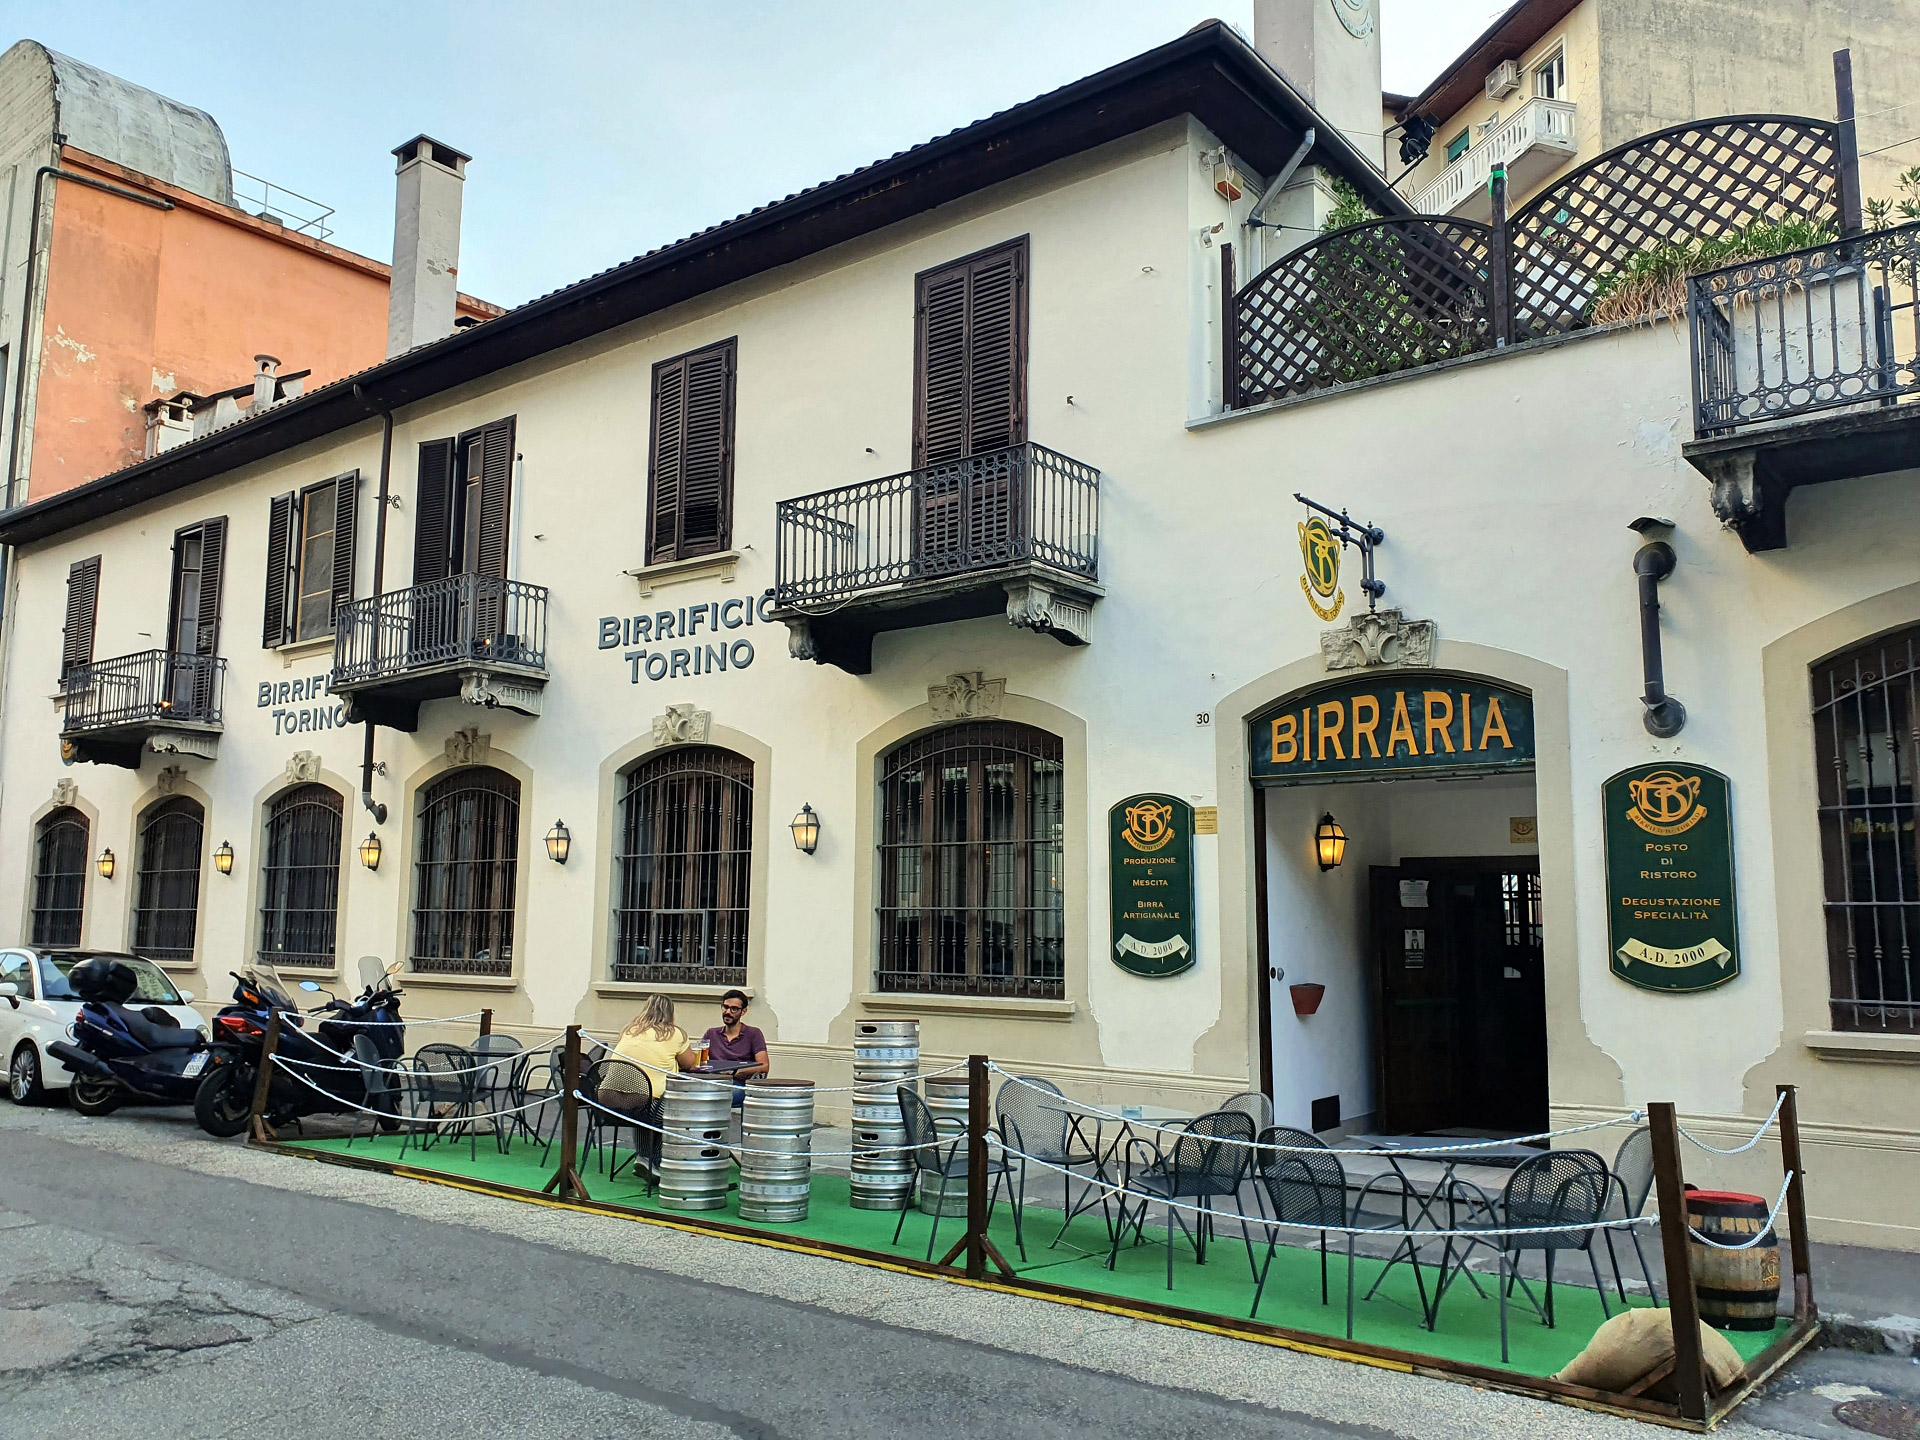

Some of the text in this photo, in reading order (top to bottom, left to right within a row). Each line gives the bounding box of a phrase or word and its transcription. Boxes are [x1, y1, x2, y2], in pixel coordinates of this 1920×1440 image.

[598, 593, 775, 650] BIRRIFICIO
[625, 639, 755, 684] TORINO
[257, 674, 334, 707] BIRRIFI
[272, 704, 348, 735] TORINO
[1196, 713, 1210, 724] 30
[1270, 691, 1514, 763] BIRRARIA
[1645, 844, 1688, 852] POSTO
[1123, 857, 1176, 865] PRODUZIONE
[1640, 870, 1697, 879] RISTORO
[1132, 879, 1168, 887] MESCITA
[1622, 897, 1721, 906] DEGUSTAZIONE
[1634, 910, 1709, 920] SPECIALITÀ
[1131, 942, 1173, 956] A.D. 2000
[1640, 947, 1705, 965] A.D. 2000
